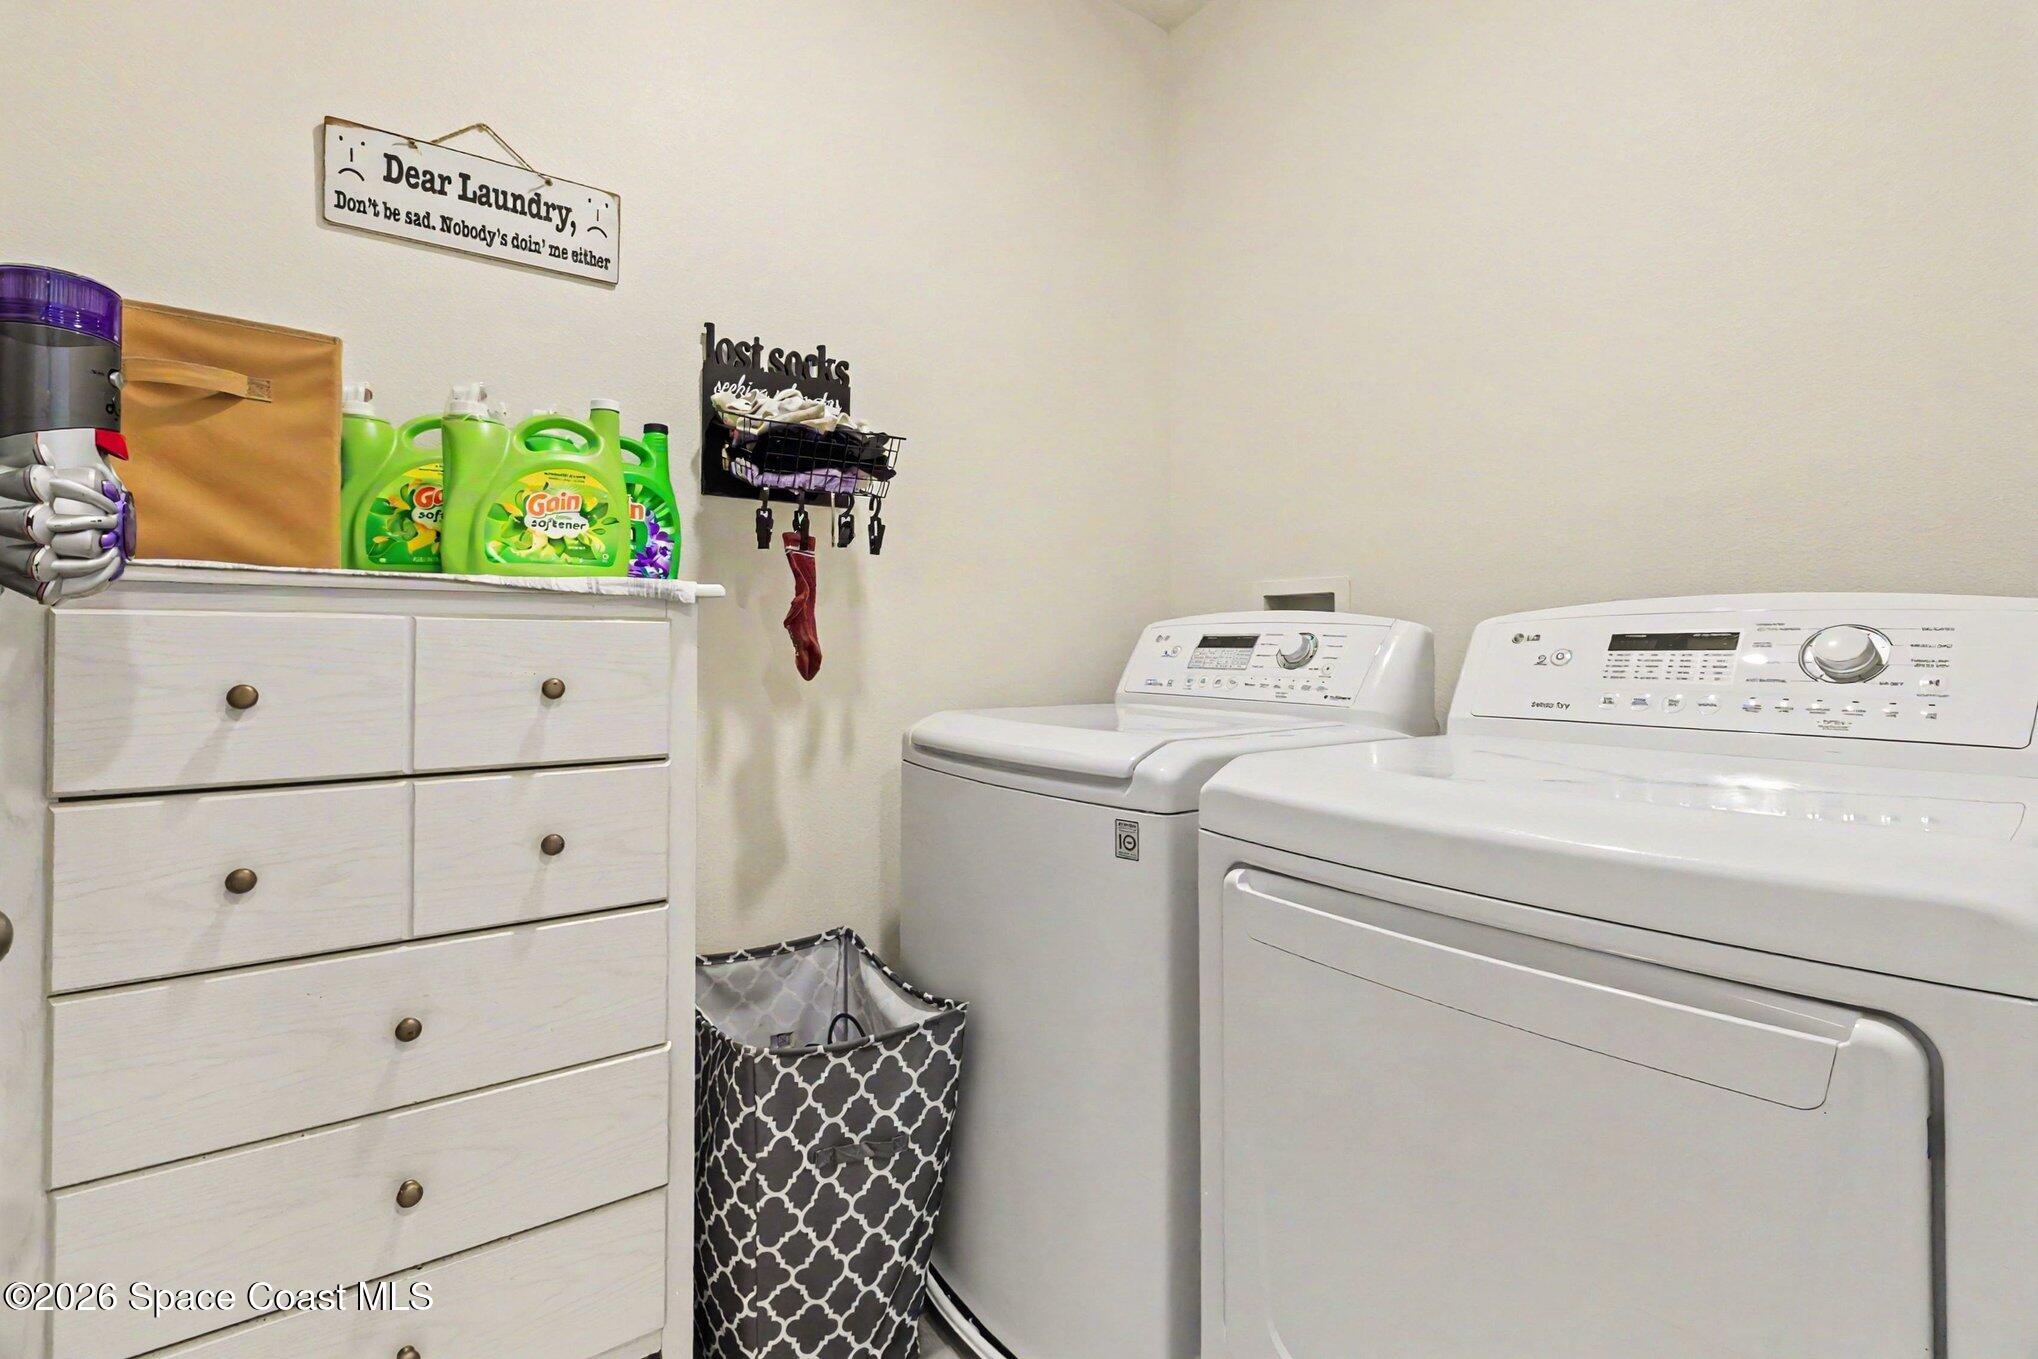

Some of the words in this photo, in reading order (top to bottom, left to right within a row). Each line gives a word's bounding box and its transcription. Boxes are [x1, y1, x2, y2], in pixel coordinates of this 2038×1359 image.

[383, 153, 452, 196] Dear
[458, 172, 577, 237] Laundry,
[334, 190, 380, 217] Don't
[383, 201, 401, 222] be
[405, 206, 436, 231] sad.
[440, 214, 508, 247] Nobody's
[511, 232, 545, 256] doin'
[549, 242, 568, 260] me
[571, 245, 611, 270] either
[704, 322, 764, 370] lost
[768, 344, 850, 388] socks
[527, 491, 582, 517] Gain
[530, 518, 587, 531] softener
